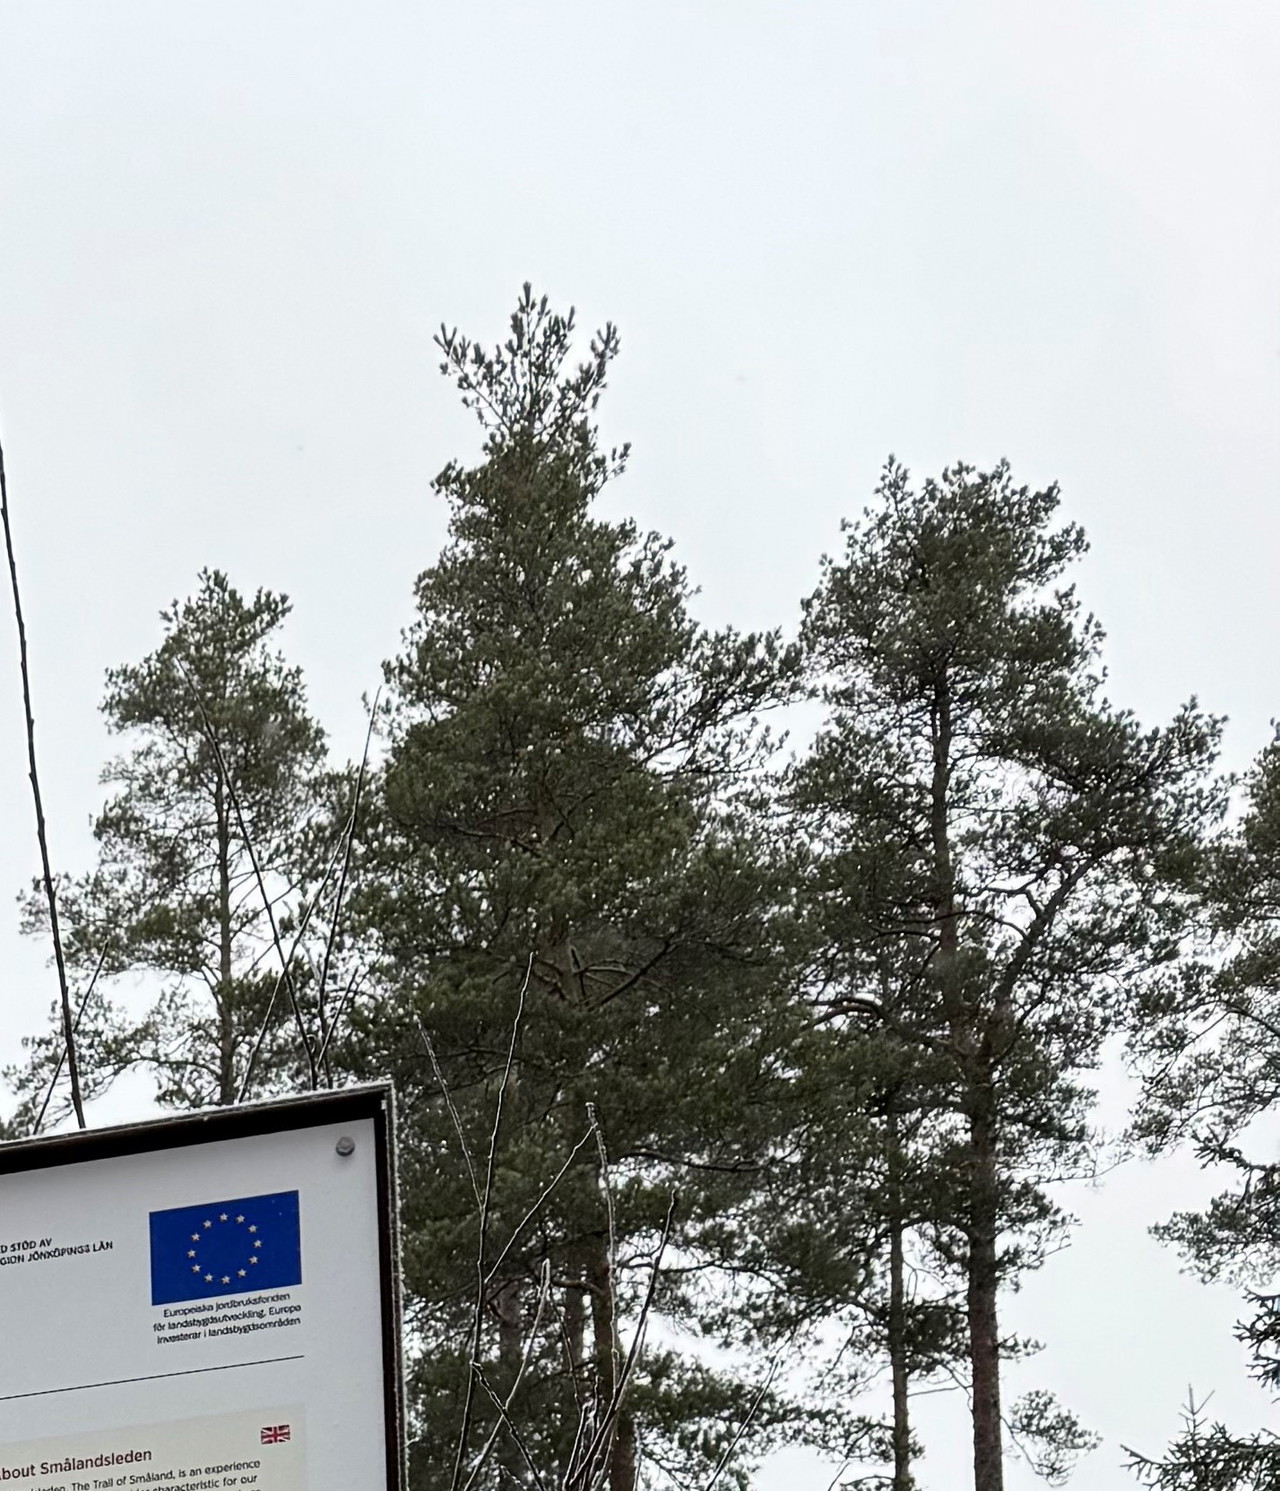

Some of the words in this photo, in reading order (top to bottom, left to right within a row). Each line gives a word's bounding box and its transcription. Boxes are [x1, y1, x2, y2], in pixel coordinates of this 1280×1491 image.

[39, 1238, 52, 1247] AV
[40, 1450, 151, 1474] Smålandsleden
[71, 1482, 89, 1491] The
[93, 1478, 113, 1488] Trail
[116, 1476, 126, 1485] of
[179, 1469, 186, 1477] is
[189, 1468, 201, 1476] an
[204, 1460, 260, 1474] experience
[223, 1477, 237, 1486] for
[241, 1475, 257, 1484] our
